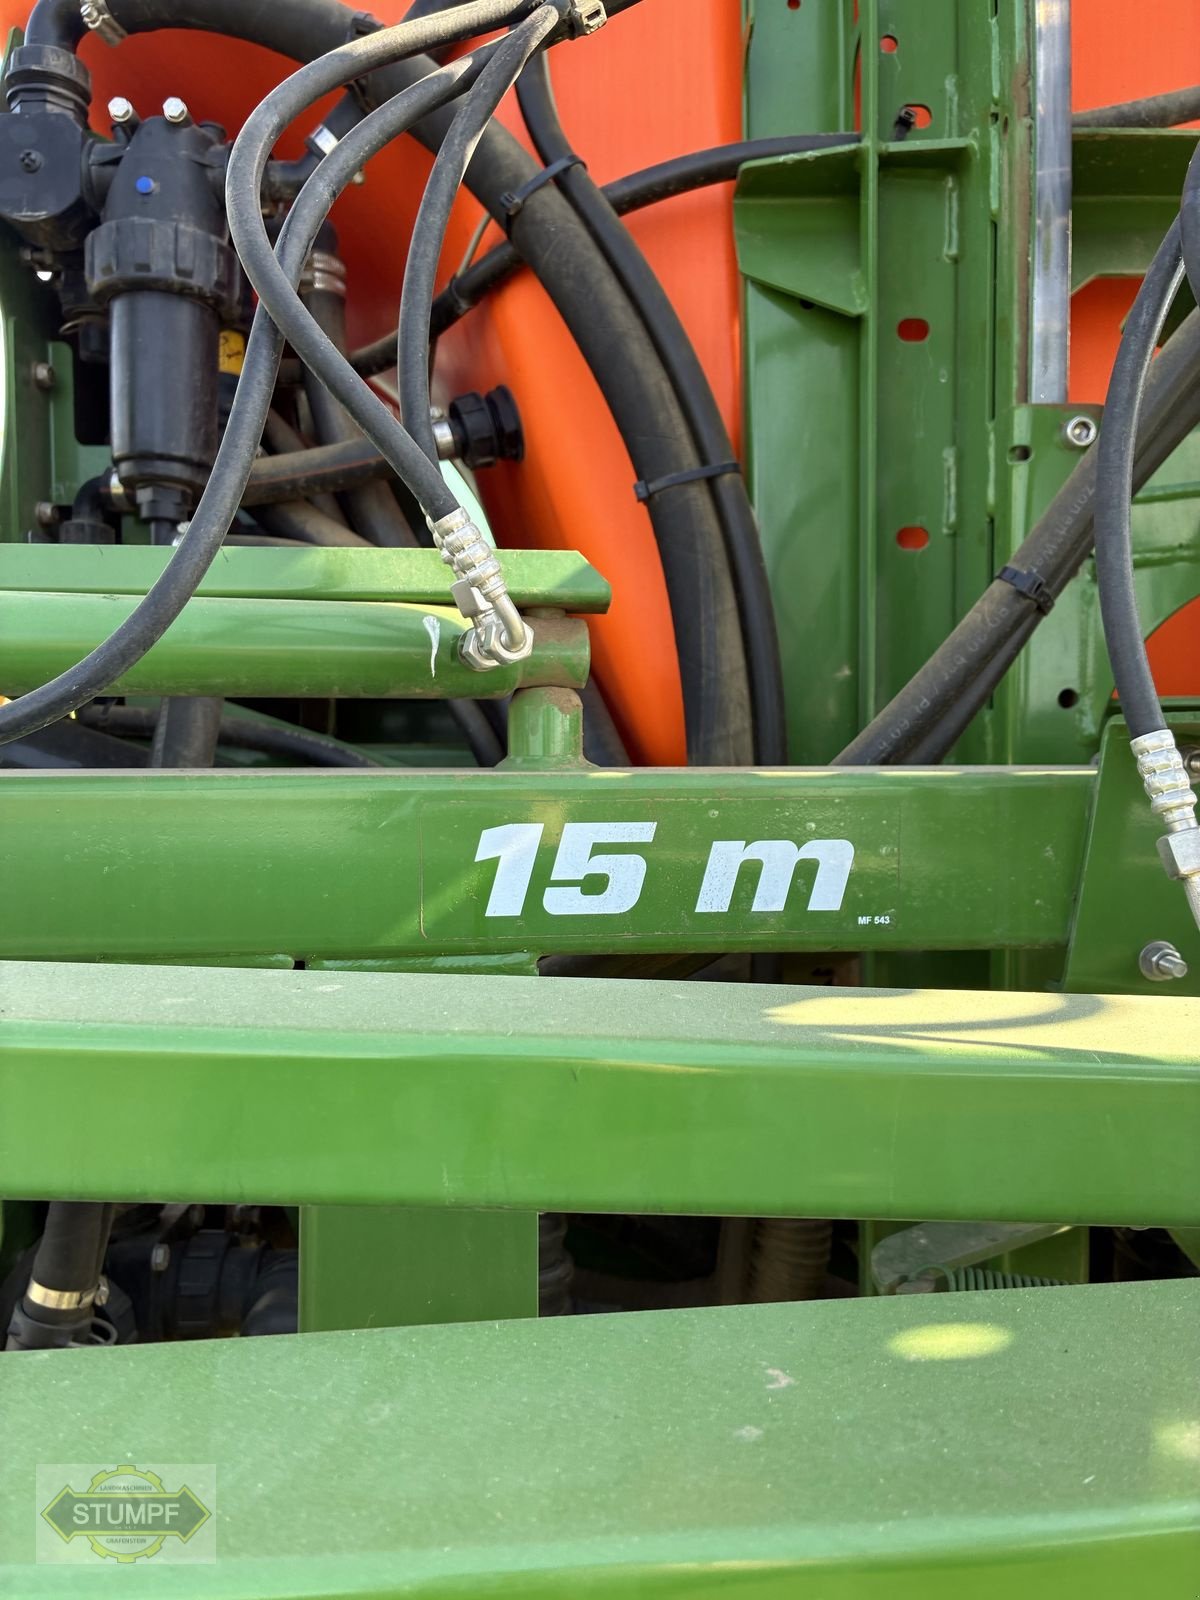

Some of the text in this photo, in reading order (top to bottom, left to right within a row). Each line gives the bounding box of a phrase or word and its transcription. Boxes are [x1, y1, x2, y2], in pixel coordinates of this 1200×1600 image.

[474, 822, 854, 917] 15 m
[858, 916, 890, 925] MF 543
